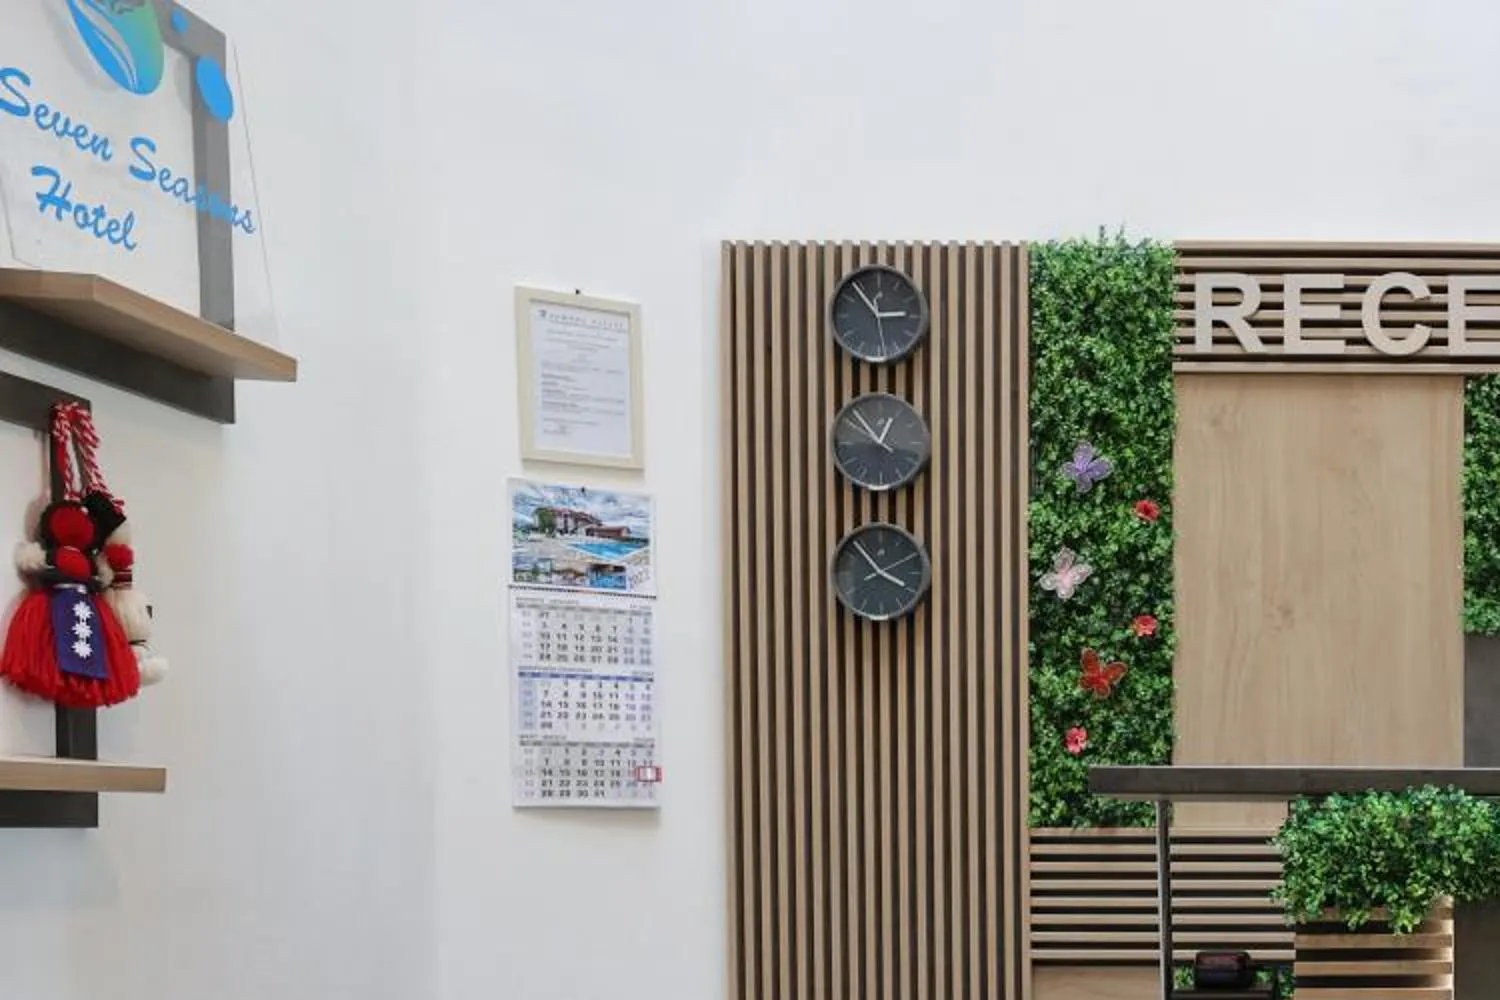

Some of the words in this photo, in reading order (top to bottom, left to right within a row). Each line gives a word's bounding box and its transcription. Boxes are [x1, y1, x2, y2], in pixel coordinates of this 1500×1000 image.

[0, 67, 112, 161] Seven
[129, 137, 256, 234] Seans
[31, 165, 137, 250] Hotel
